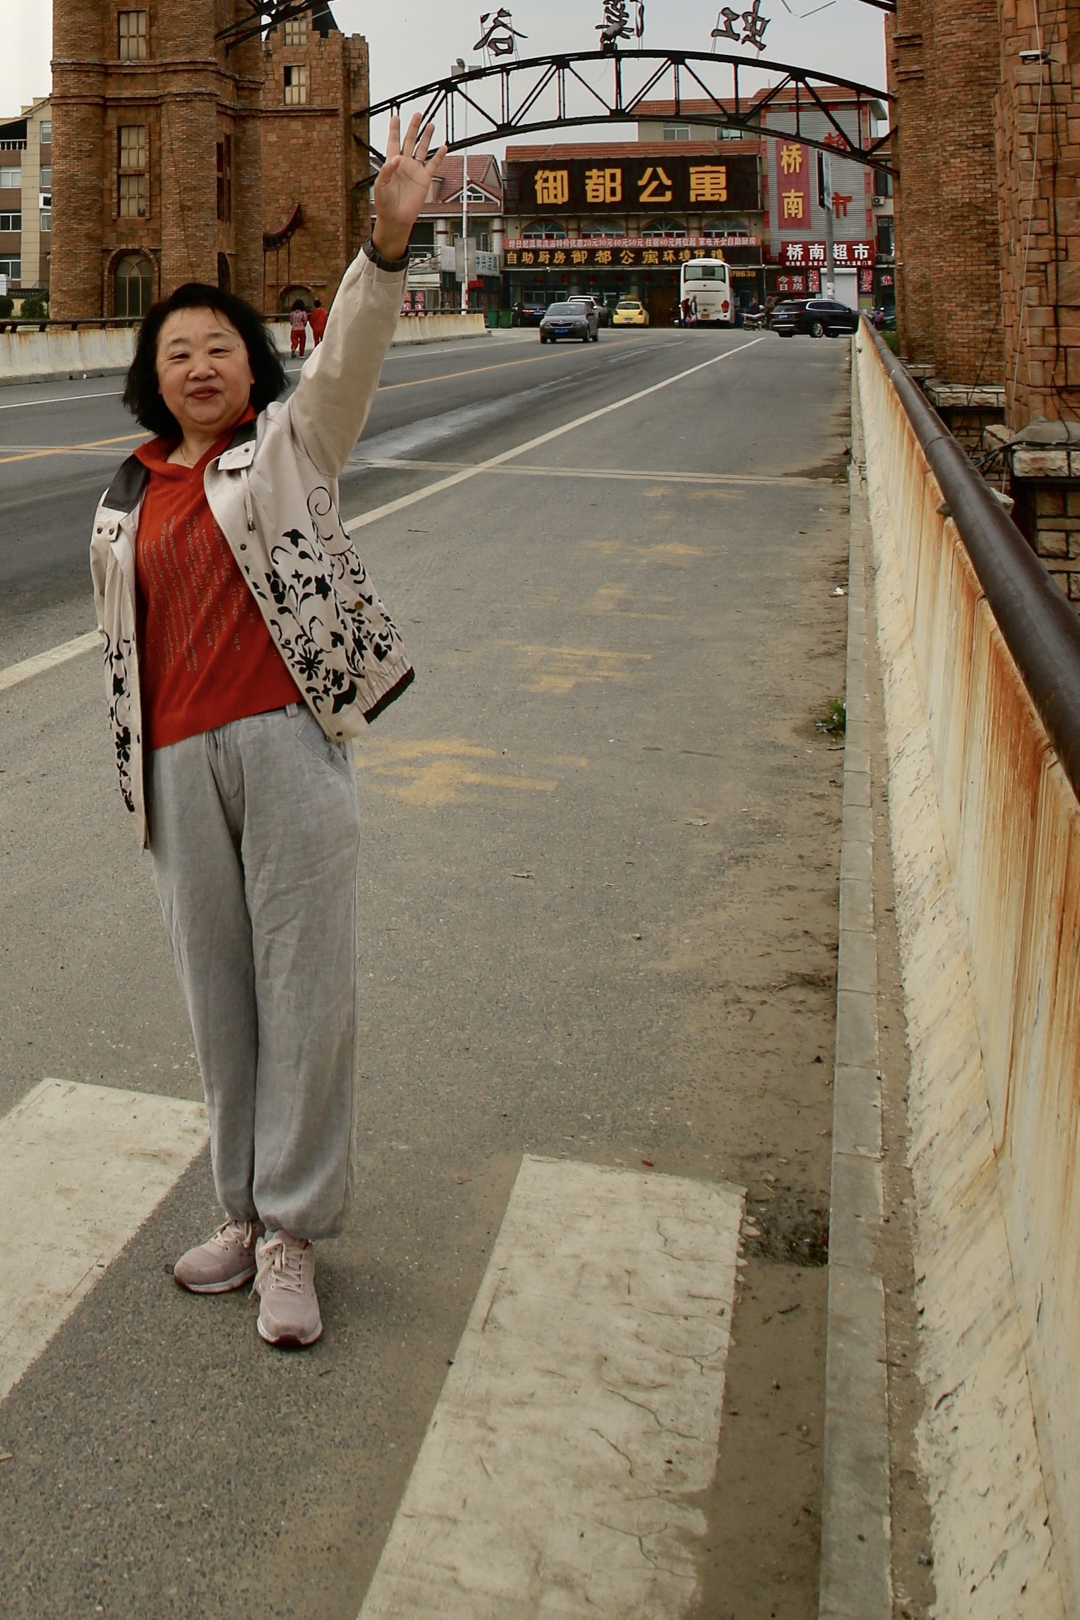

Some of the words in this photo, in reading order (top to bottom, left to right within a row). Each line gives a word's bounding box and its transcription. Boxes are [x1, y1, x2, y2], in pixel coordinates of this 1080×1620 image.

[534, 165, 728, 205] 御都公寓
[780, 143, 804, 219] 桥南
[786, 243, 870, 261] 桥南超市
